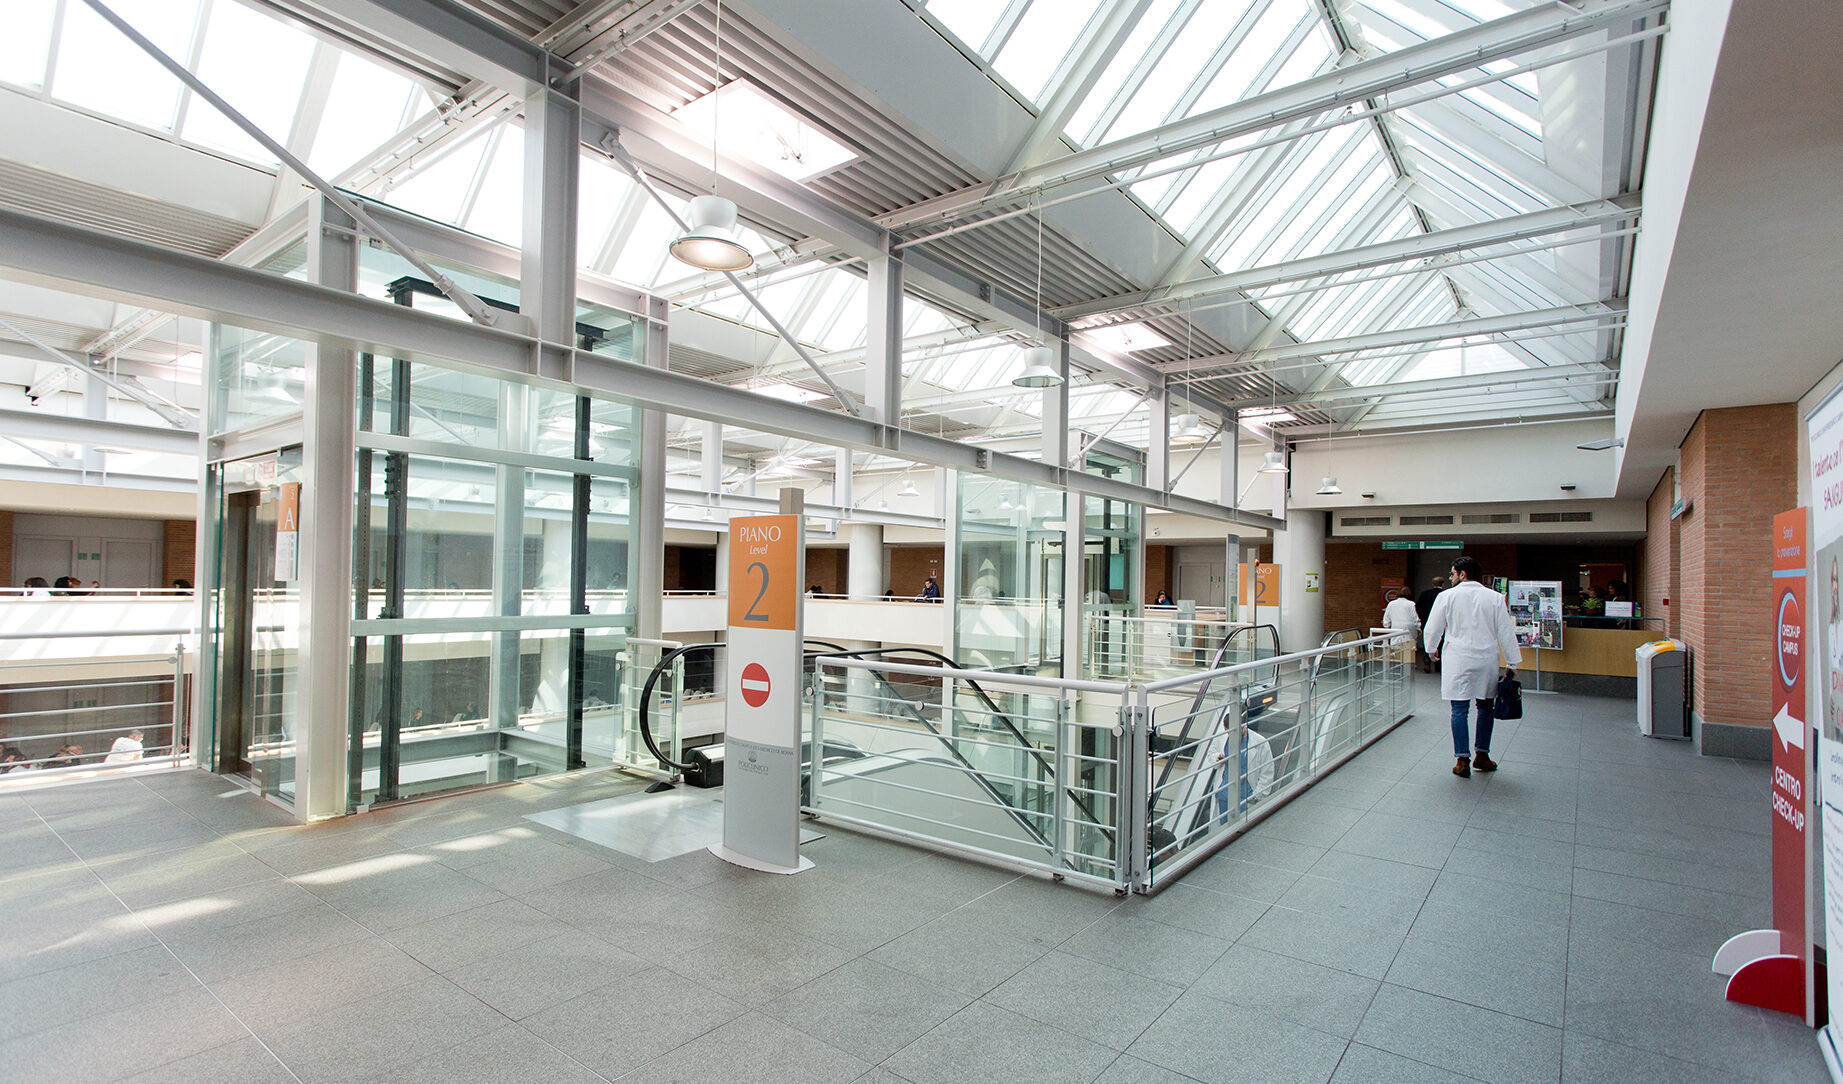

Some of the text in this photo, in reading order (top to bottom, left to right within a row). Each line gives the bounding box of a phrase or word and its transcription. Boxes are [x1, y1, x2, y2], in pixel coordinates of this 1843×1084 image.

[284, 507, 295, 530] A
[739, 525, 781, 543] PIANO
[749, 544, 768, 555] Level
[743, 561, 770, 622] 2
[1782, 624, 1801, 638] CHECK-UP
[1783, 640, 1799, 655] CAMPUS
[738, 760, 769, 773] POLICLINICO
[1775, 765, 1801, 801] CENTRO
[1772, 790, 1805, 832] CHECK-UP
